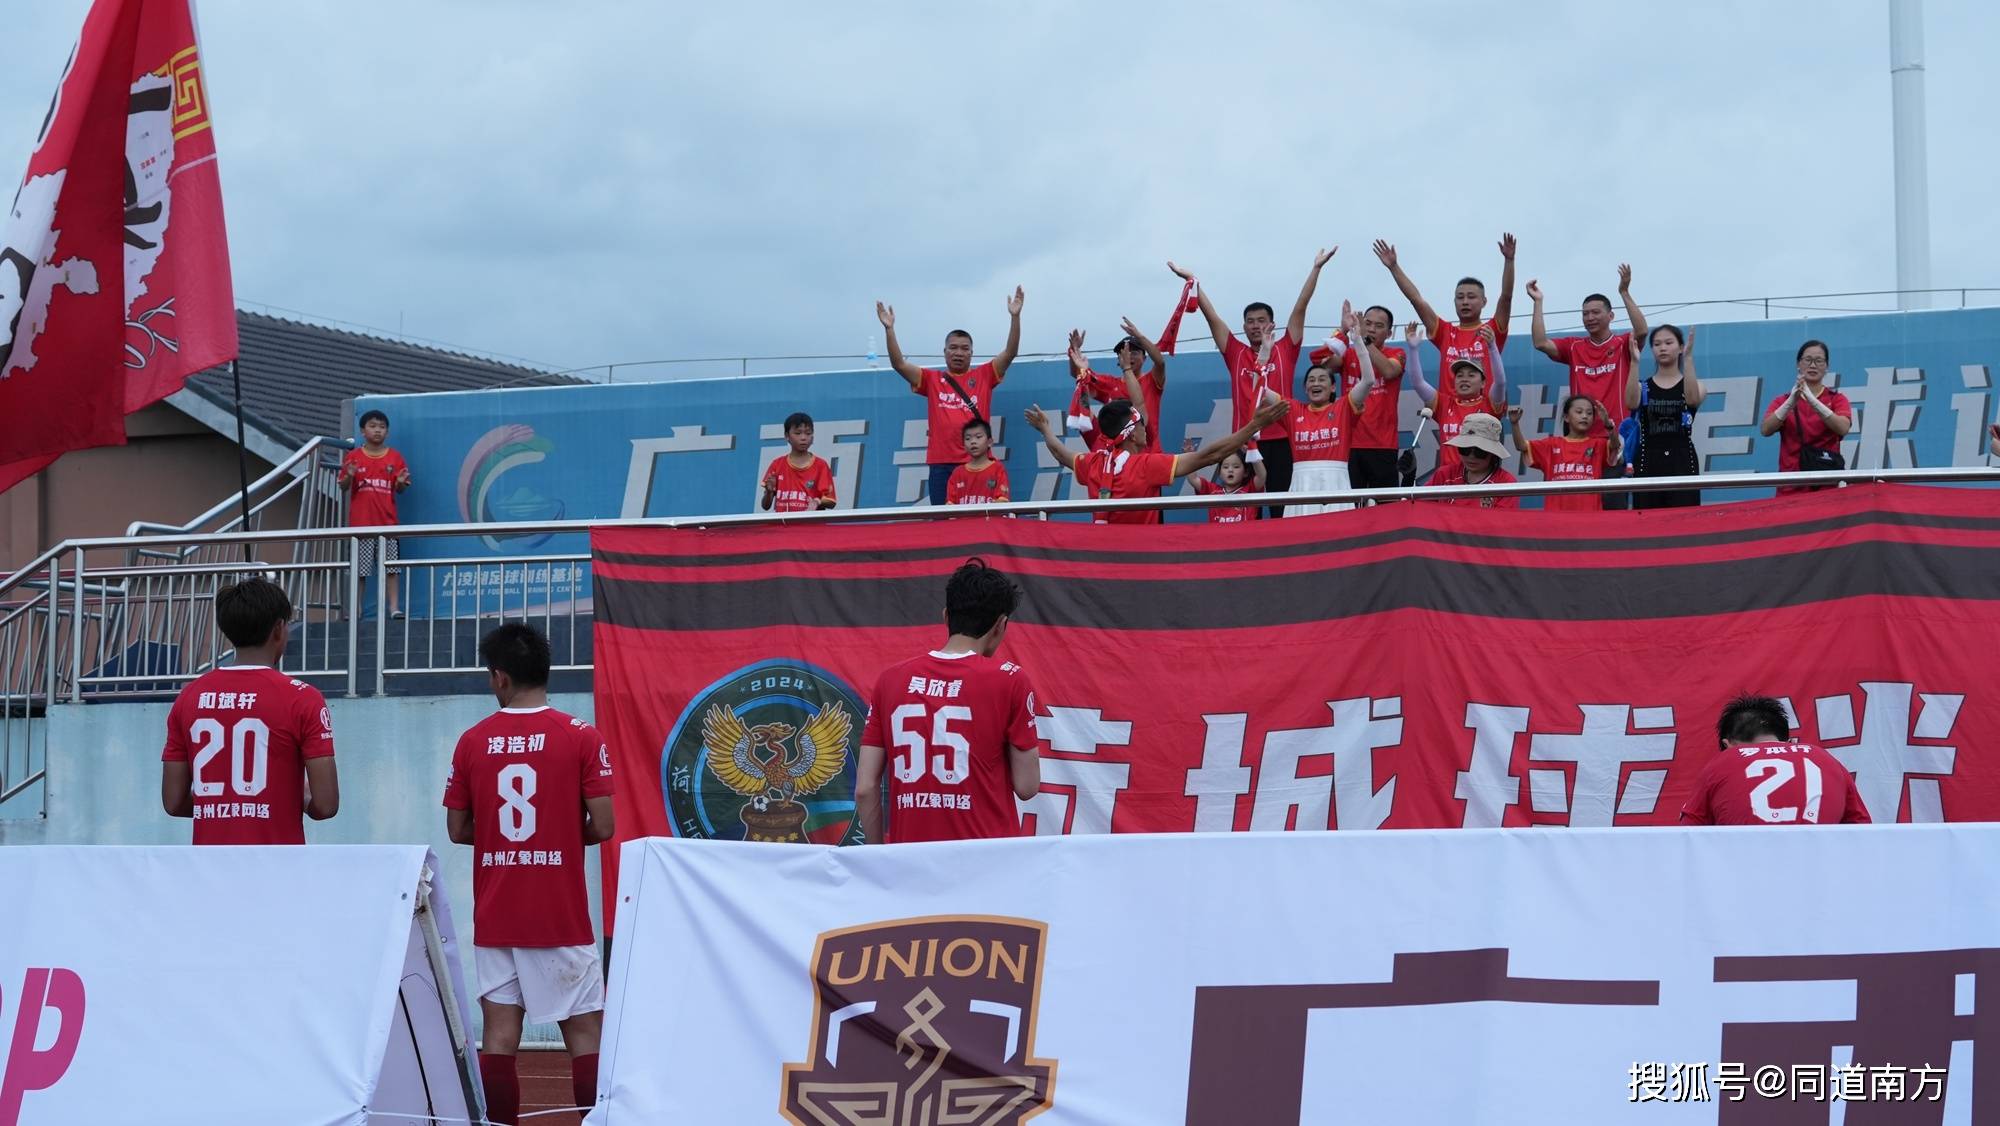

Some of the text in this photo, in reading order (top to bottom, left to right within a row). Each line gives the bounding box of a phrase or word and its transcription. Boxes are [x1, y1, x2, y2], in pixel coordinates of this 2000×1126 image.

[487, 587, 520, 596] FOOBALL
[751, 676, 803, 691] 2024
[908, 676, 963, 698] 吴欣睿
[198, 692, 257, 710] 和斌轩
[487, 733, 546, 754] 凌浩初
[891, 703, 972, 785] 55
[190, 717, 270, 797] 20
[672, 765, 690, 794] 荷
[897, 792, 971, 811] 州亿象网络
[1745, 758, 1822, 824] 21
[497, 763, 537, 842] 8
[481, 850, 563, 867] 贵州亿象网络
[827, 937, 1028, 985] UNION
